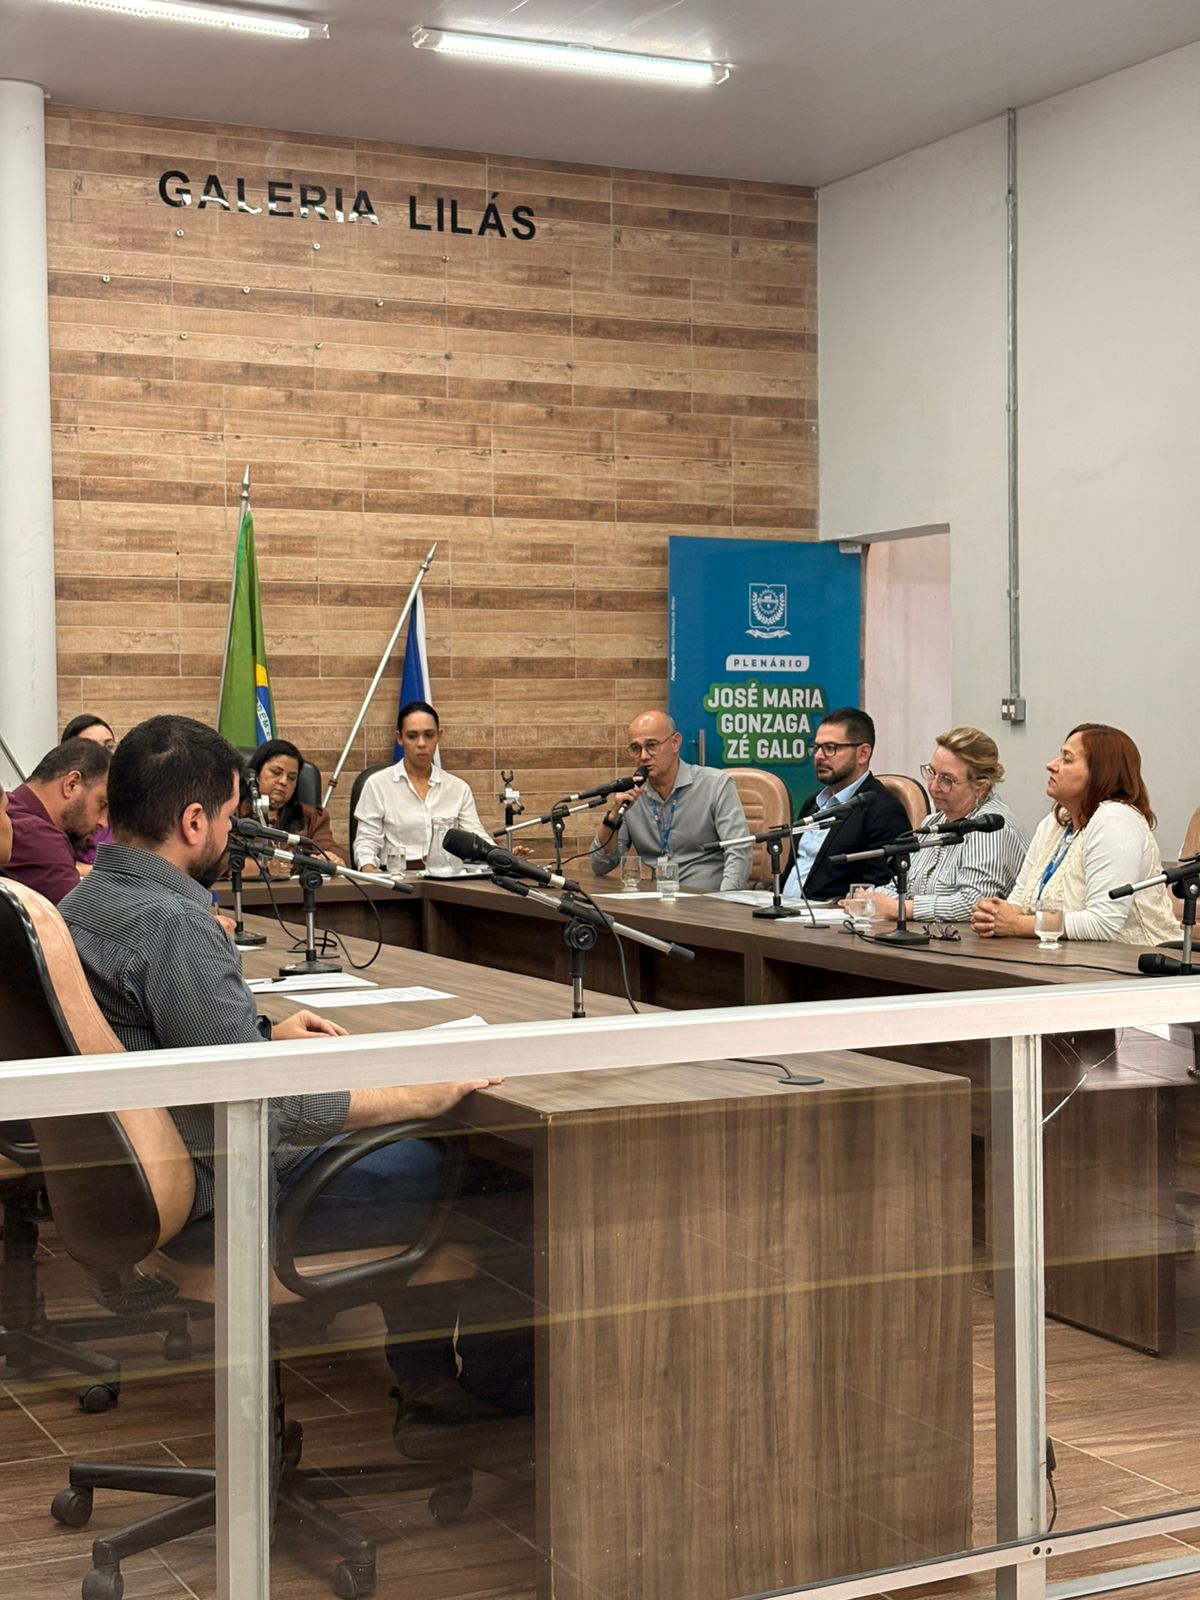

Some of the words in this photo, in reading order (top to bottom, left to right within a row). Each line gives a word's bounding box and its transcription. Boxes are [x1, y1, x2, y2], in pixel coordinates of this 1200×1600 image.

[158, 170, 380, 226] GALERIA
[409, 192, 537, 241] LILÁS
[733, 657, 802, 668] PLENÁRIO
[707, 682, 758, 708] JOSÉ
[763, 688, 824, 708] MARIA
[257, 703, 269, 728] DEM
[721, 713, 811, 734] GONZAGA
[727, 734, 750, 759] ZÉ
[756, 738, 805, 759] GALO
